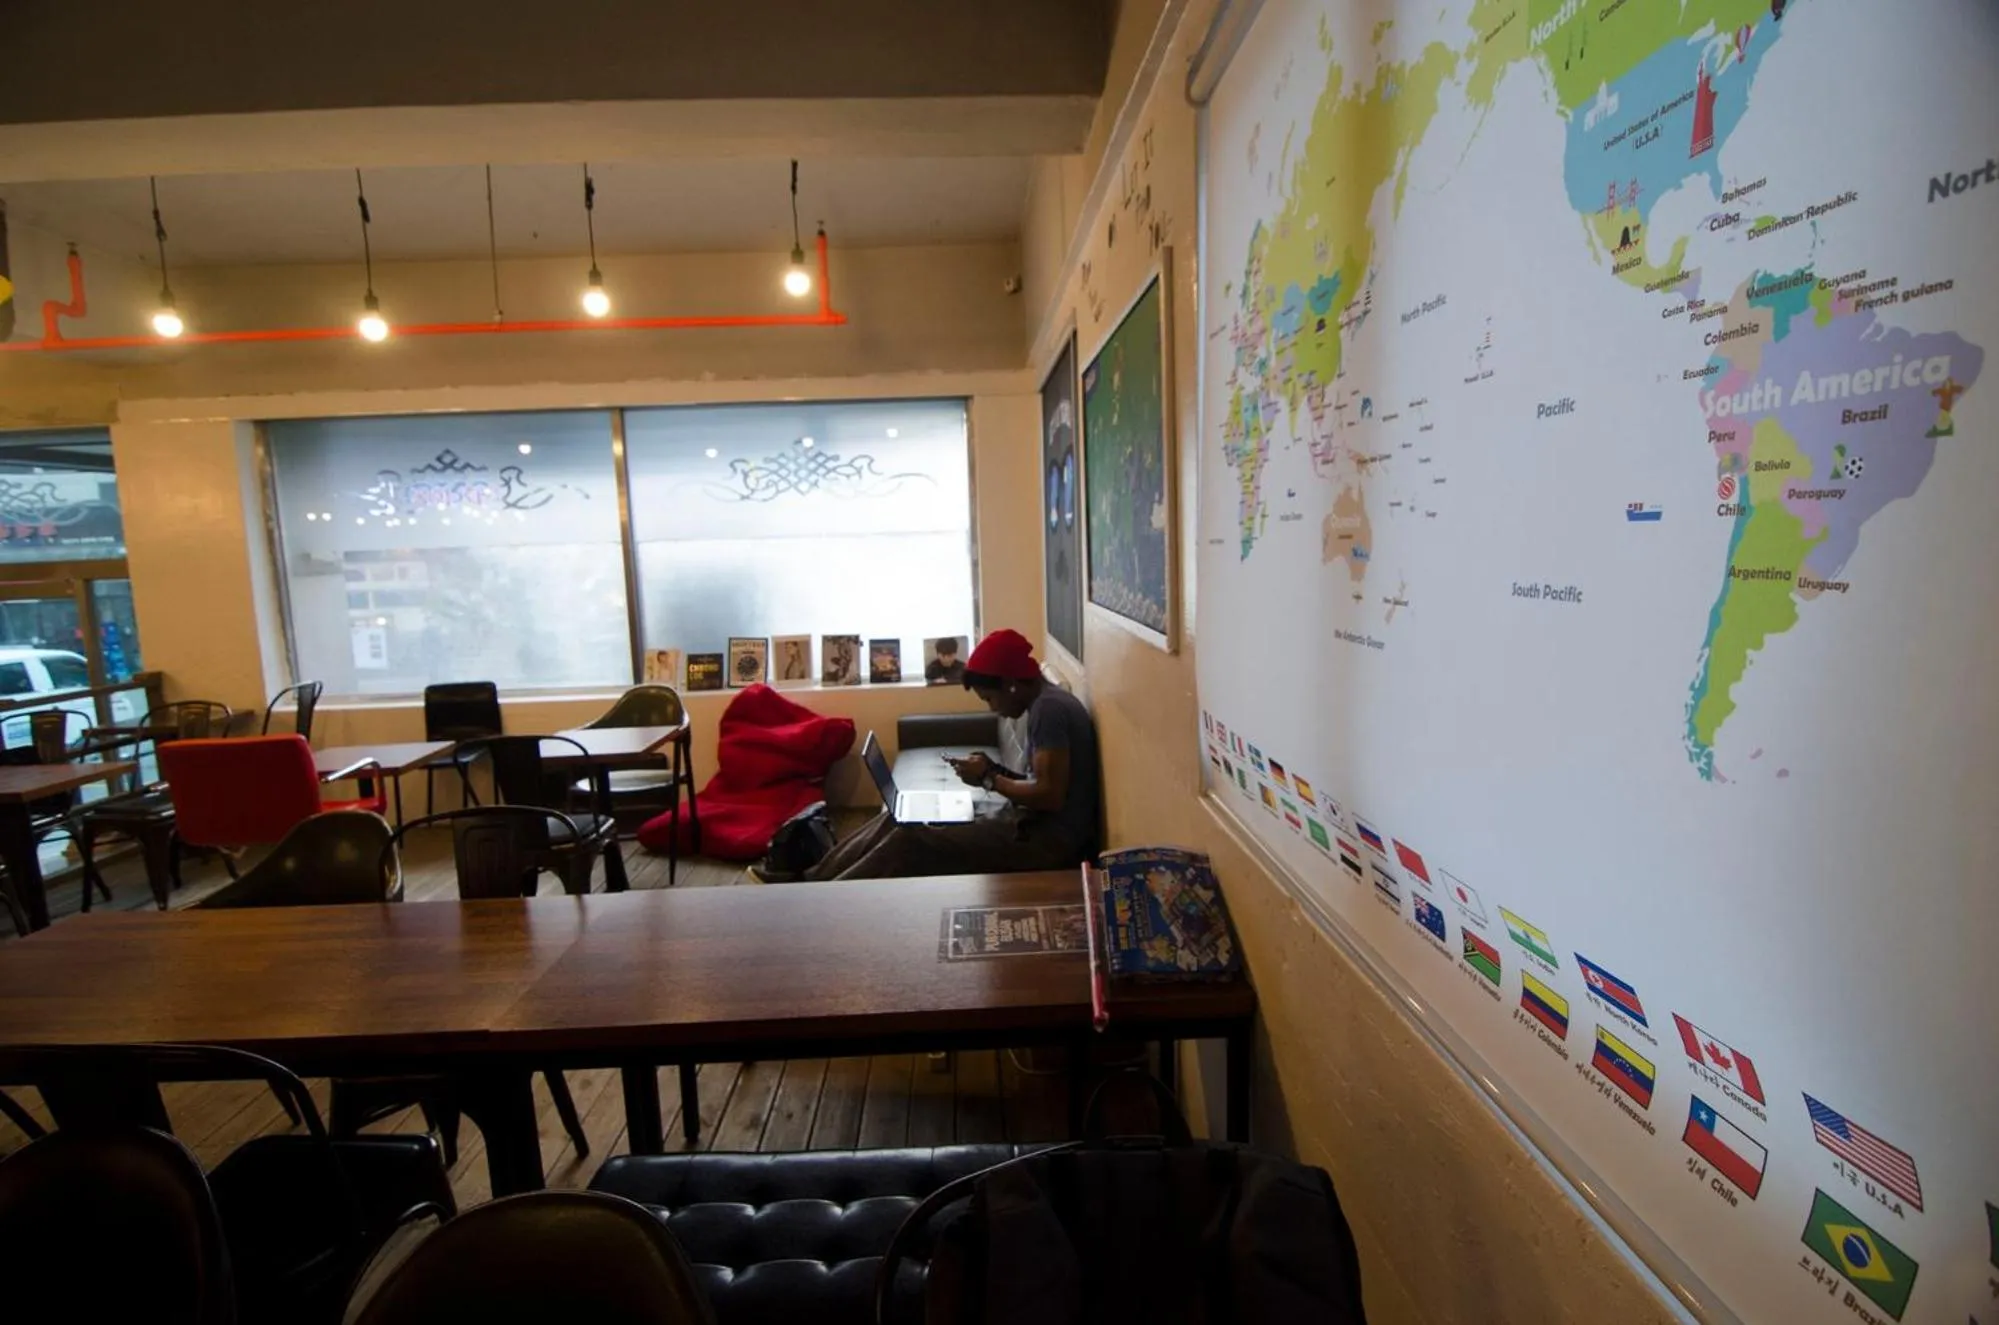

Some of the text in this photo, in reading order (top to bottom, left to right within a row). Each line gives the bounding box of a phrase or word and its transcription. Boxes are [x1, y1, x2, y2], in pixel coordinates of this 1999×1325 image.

[1604, 128, 1627, 151] United
[1660, 90, 1694, 116] America
[1721, 177, 1767, 204] Bahamas
[1928, 159, 1999, 203] Nort
[1709, 212, 1740, 231] Cuba
[1748, 191, 1858, 241] Dominican Republic
[1611, 256, 1642, 276] Mexico
[1644, 270, 1690, 293] Guatemala
[1817, 269, 1867, 291] Guyana
[1837, 276, 1898, 302] Suriname
[1854, 279, 1954, 313] French guiana
[1661, 298, 1706, 320] Costa Rica
[1689, 304, 1728, 324] Panama
[1704, 322, 1759, 346] Colombia
[1682, 364, 1720, 381] Ecuador
[1703, 354, 1952, 420] South America
[1536, 398, 1575, 420] Pacific
[1841, 404, 1889, 425] Brazil
[1707, 430, 1736, 445] Peru
[1754, 459, 1791, 473] Bolivia
[1787, 487, 1846, 502] Paraguay
[1717, 503, 1747, 517] Chile
[1727, 564, 1791, 581] Argentina
[1512, 581, 1583, 604] South Pacific
[1798, 576, 1850, 594] Uruguay
[1722, 1083, 1767, 1122] Canada
[1686, 1157, 1738, 1208] 칠레 Chile
[1832, 1160, 1905, 1220] 미국 U.S.A
[1798, 1256, 1839, 1297] 브라질
